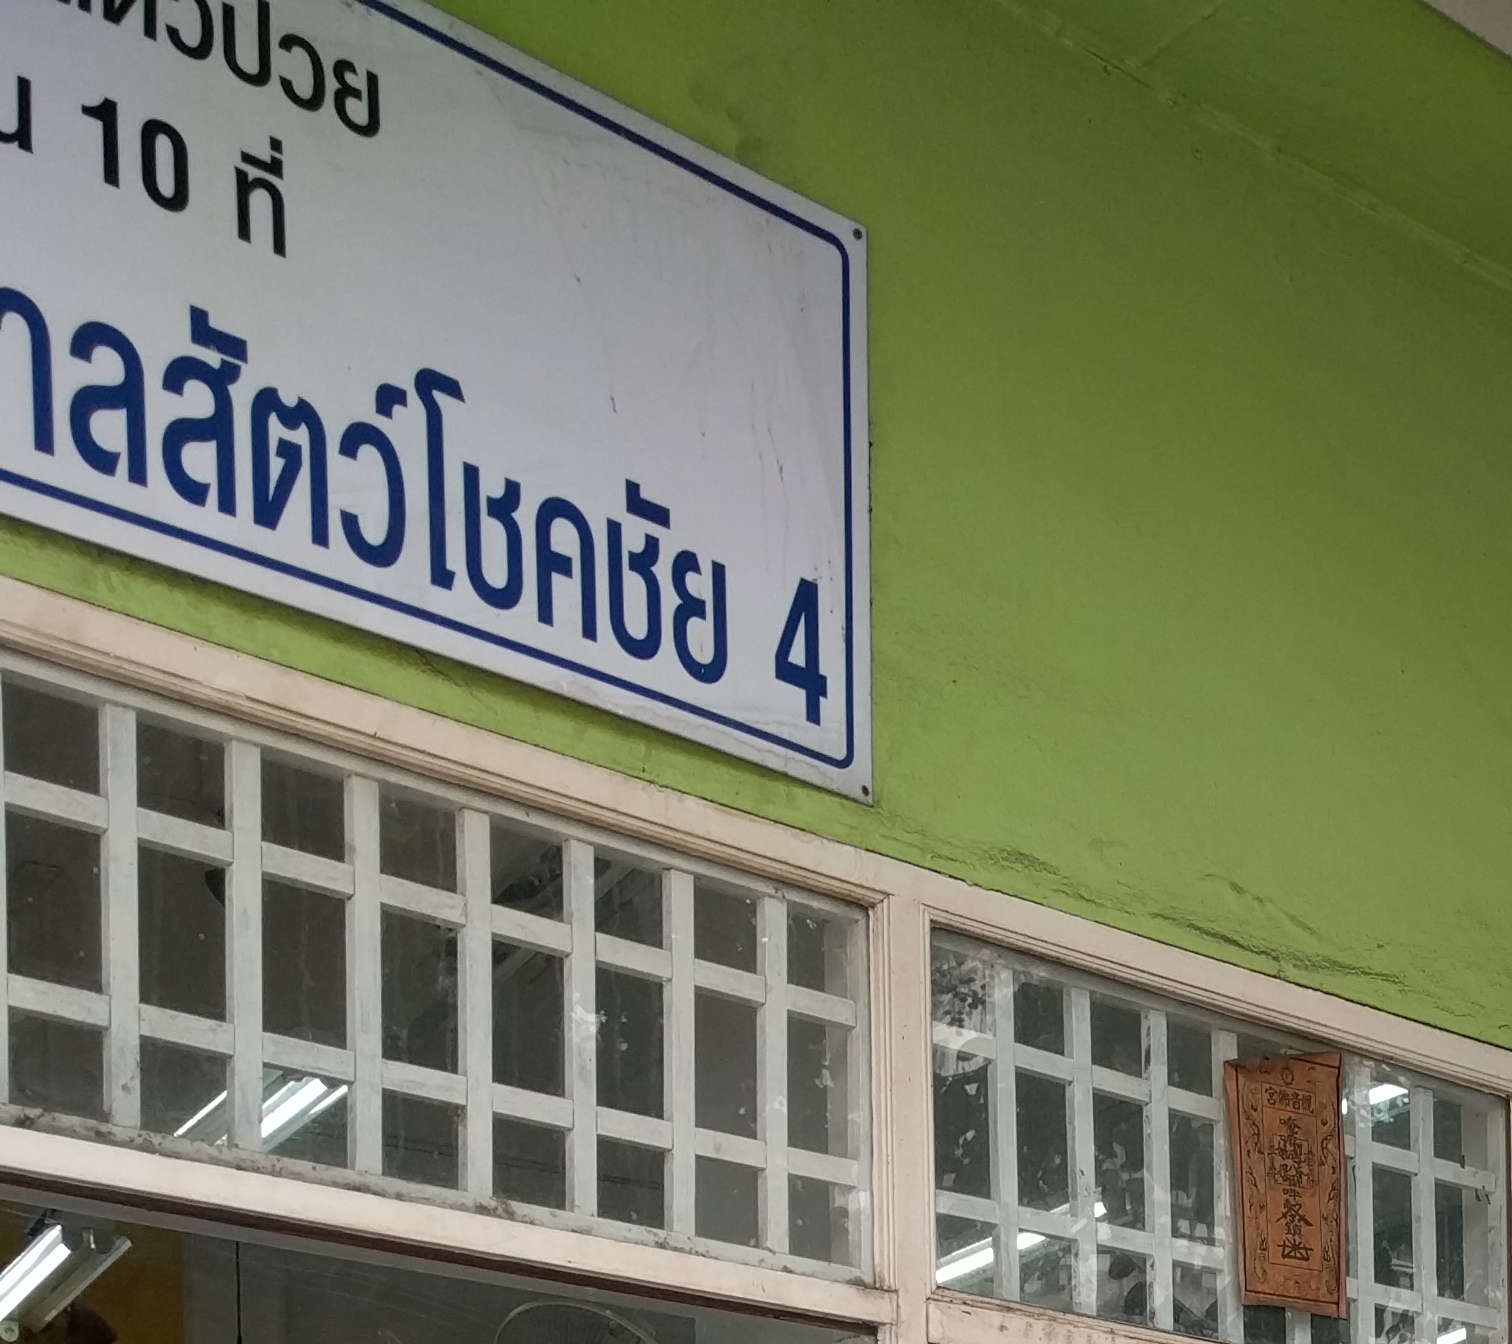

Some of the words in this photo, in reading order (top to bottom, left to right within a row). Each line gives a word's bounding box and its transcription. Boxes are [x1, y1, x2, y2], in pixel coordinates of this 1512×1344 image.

[81, 97, 190, 213] 10
[234, 135, 287, 259] ที่
[774, 577, 828, 727] 4
